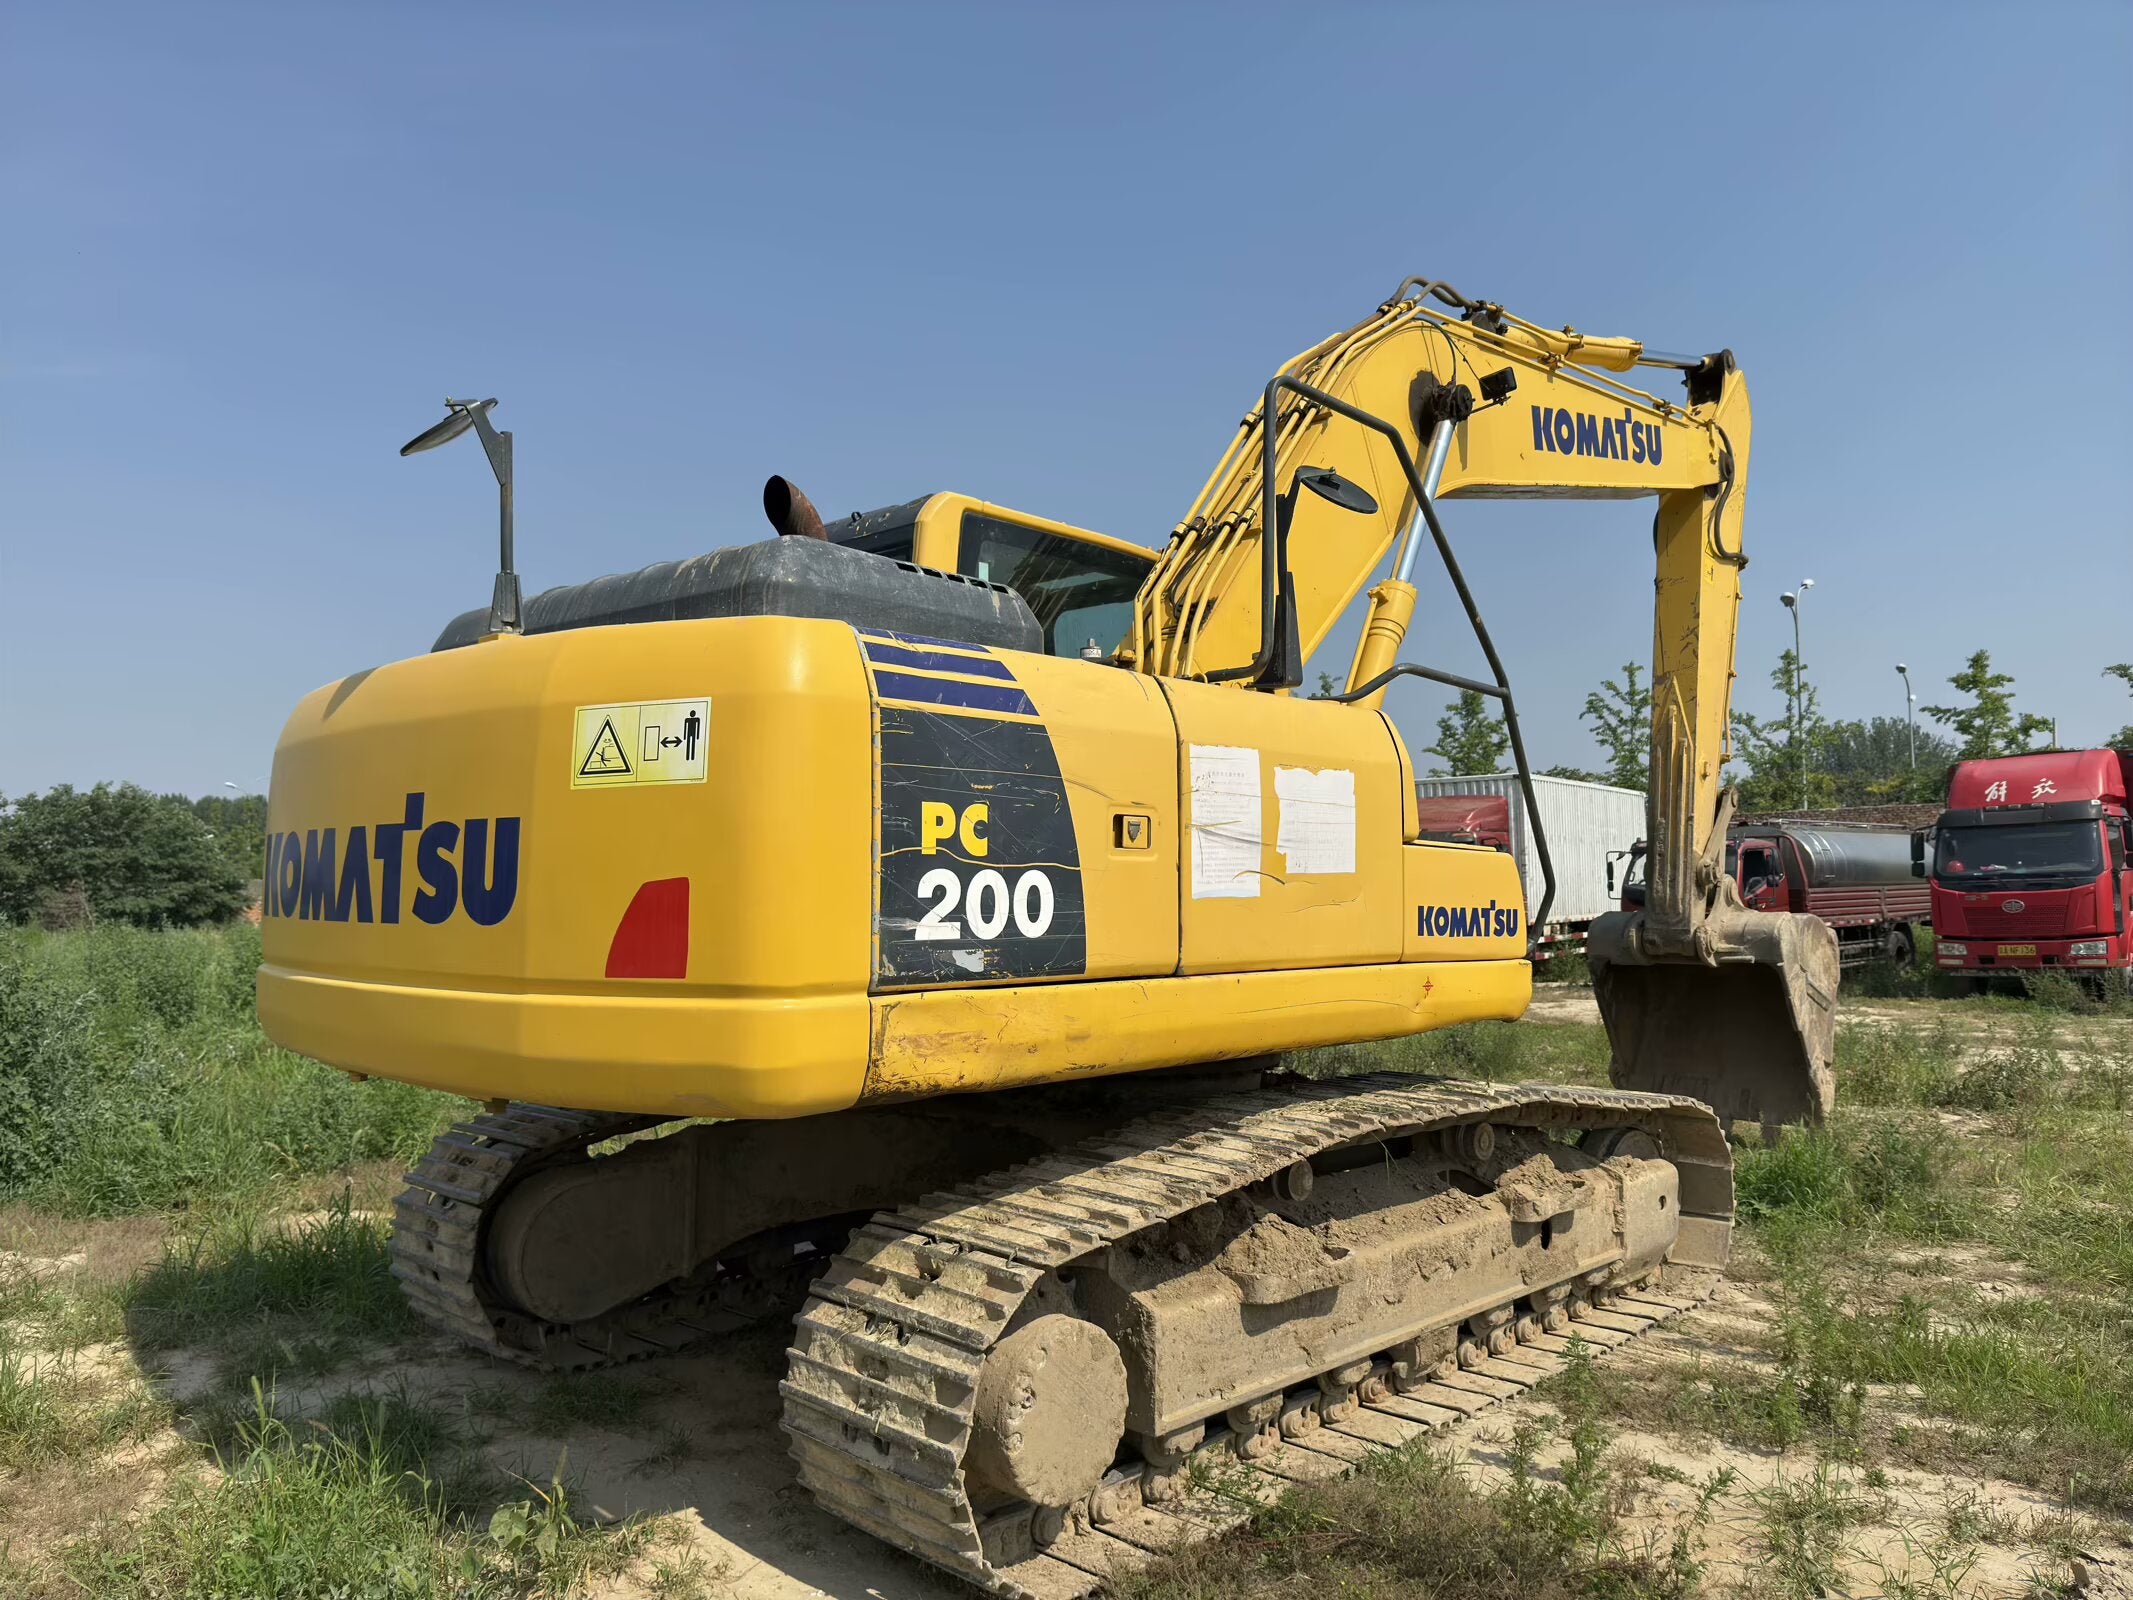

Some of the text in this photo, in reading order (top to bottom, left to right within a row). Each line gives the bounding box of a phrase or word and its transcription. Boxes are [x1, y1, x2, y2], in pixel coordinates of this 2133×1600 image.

[1531, 405, 1663, 466] KOMATSU
[264, 792, 521, 927] KOMATSU
[921, 801, 989, 857] PC
[914, 868, 1055, 941] 200
[1417, 900, 1518, 937] KOMATSU
